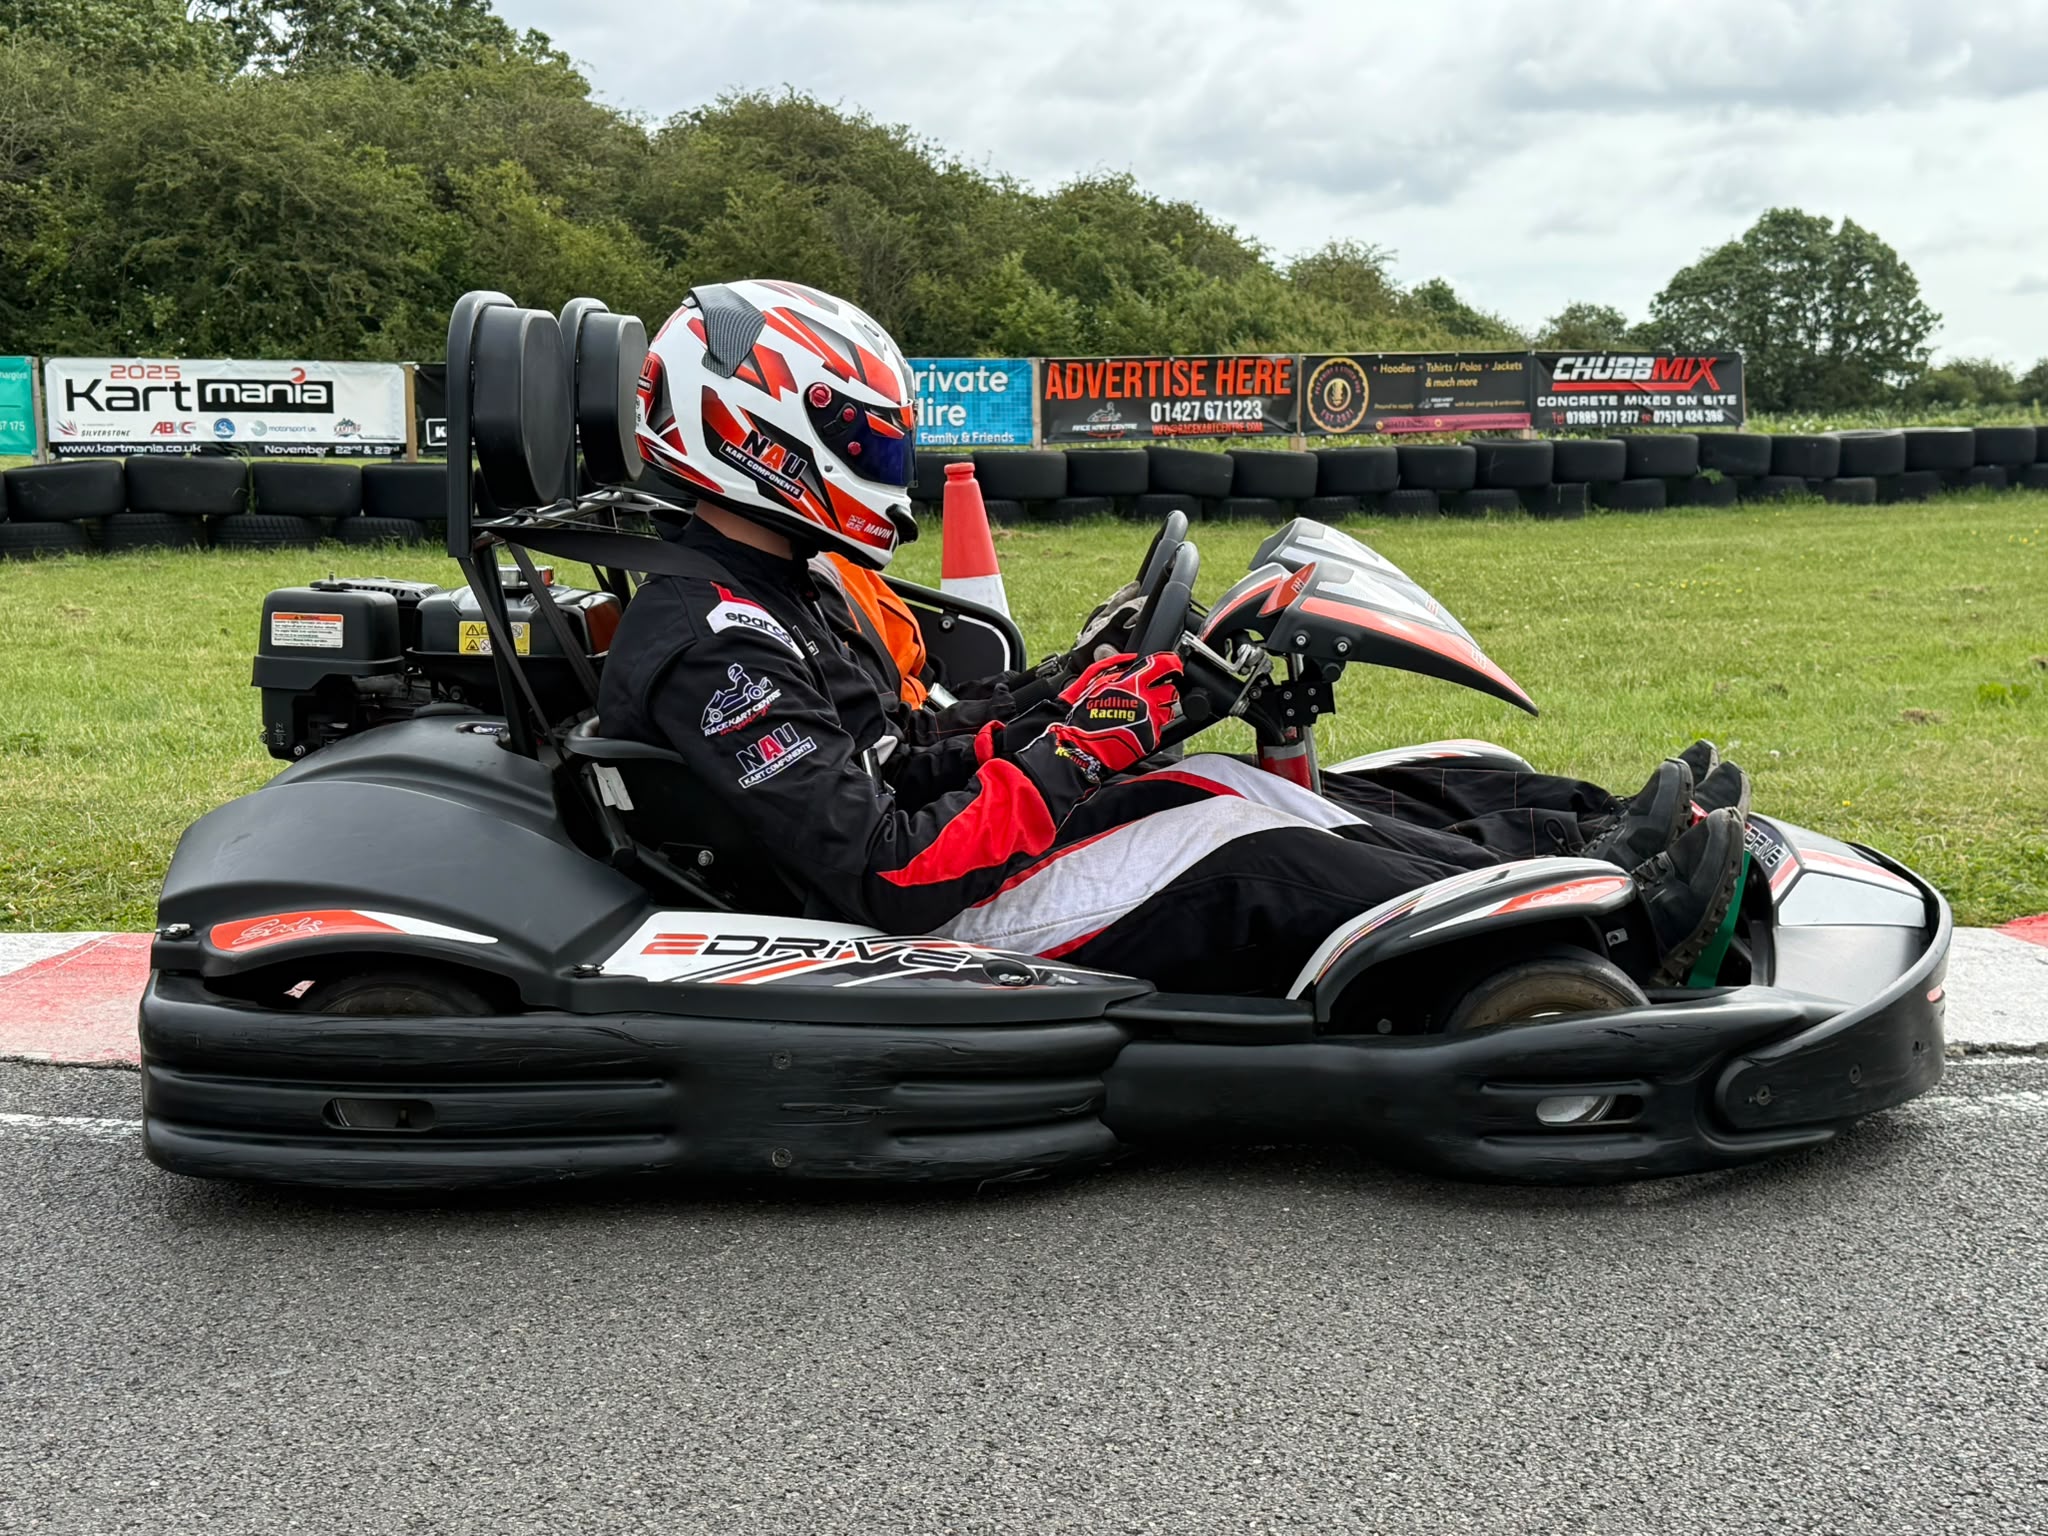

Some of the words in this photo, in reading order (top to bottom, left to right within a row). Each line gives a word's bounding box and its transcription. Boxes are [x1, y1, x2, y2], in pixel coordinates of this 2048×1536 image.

[110, 365, 181, 380] 2025
[1380, 363, 1415, 373] Hoodies
[1426, 362, 1452, 372] Tshirts
[1459, 362, 1482, 371] Polos
[1492, 361, 1523, 371] Jackets
[1552, 357, 1720, 389] CHUBBMIX
[915, 364, 1009, 392] rivate
[1045, 360, 1207, 399] ADVERTISE
[1216, 359, 1292, 396] HERE
[1433, 377, 1455, 387] much
[1456, 378, 1478, 387] more
[65, 379, 193, 411] Kart
[205, 370, 328, 404] mania
[1537, 395, 1618, 407] CONCRETE
[1624, 395, 1671, 406] MIXED
[1676, 395, 1697, 405] ON
[1703, 395, 1737, 405] SITE
[1150, 401, 1201, 422] 01427
[1204, 400, 1263, 421] 671223
[1620, 410, 1639, 424] 277
[920, 432, 959, 445] Family
[961, 432, 970, 443] &
[972, 432, 1015, 443] Friends
[58, 443, 202, 454] www.kartmania.co.uk
[264, 444, 329, 454] November
[740, 429, 808, 480] NAU
[725, 445, 747, 462] KART
[746, 460, 801, 496] COMPONENTS
[863, 523, 893, 539] MAVIN
[704, 721, 729, 736] RACE
[728, 708, 752, 726] KART
[752, 689, 782, 712] CENTRE
[1086, 697, 1138, 709] Gridline
[1090, 708, 1136, 721] Racing
[736, 722, 801, 774] NAU
[744, 770, 766, 785] KART
[765, 741, 812, 774] COMPONENTS
[1744, 822, 1788, 868] DRIVE
